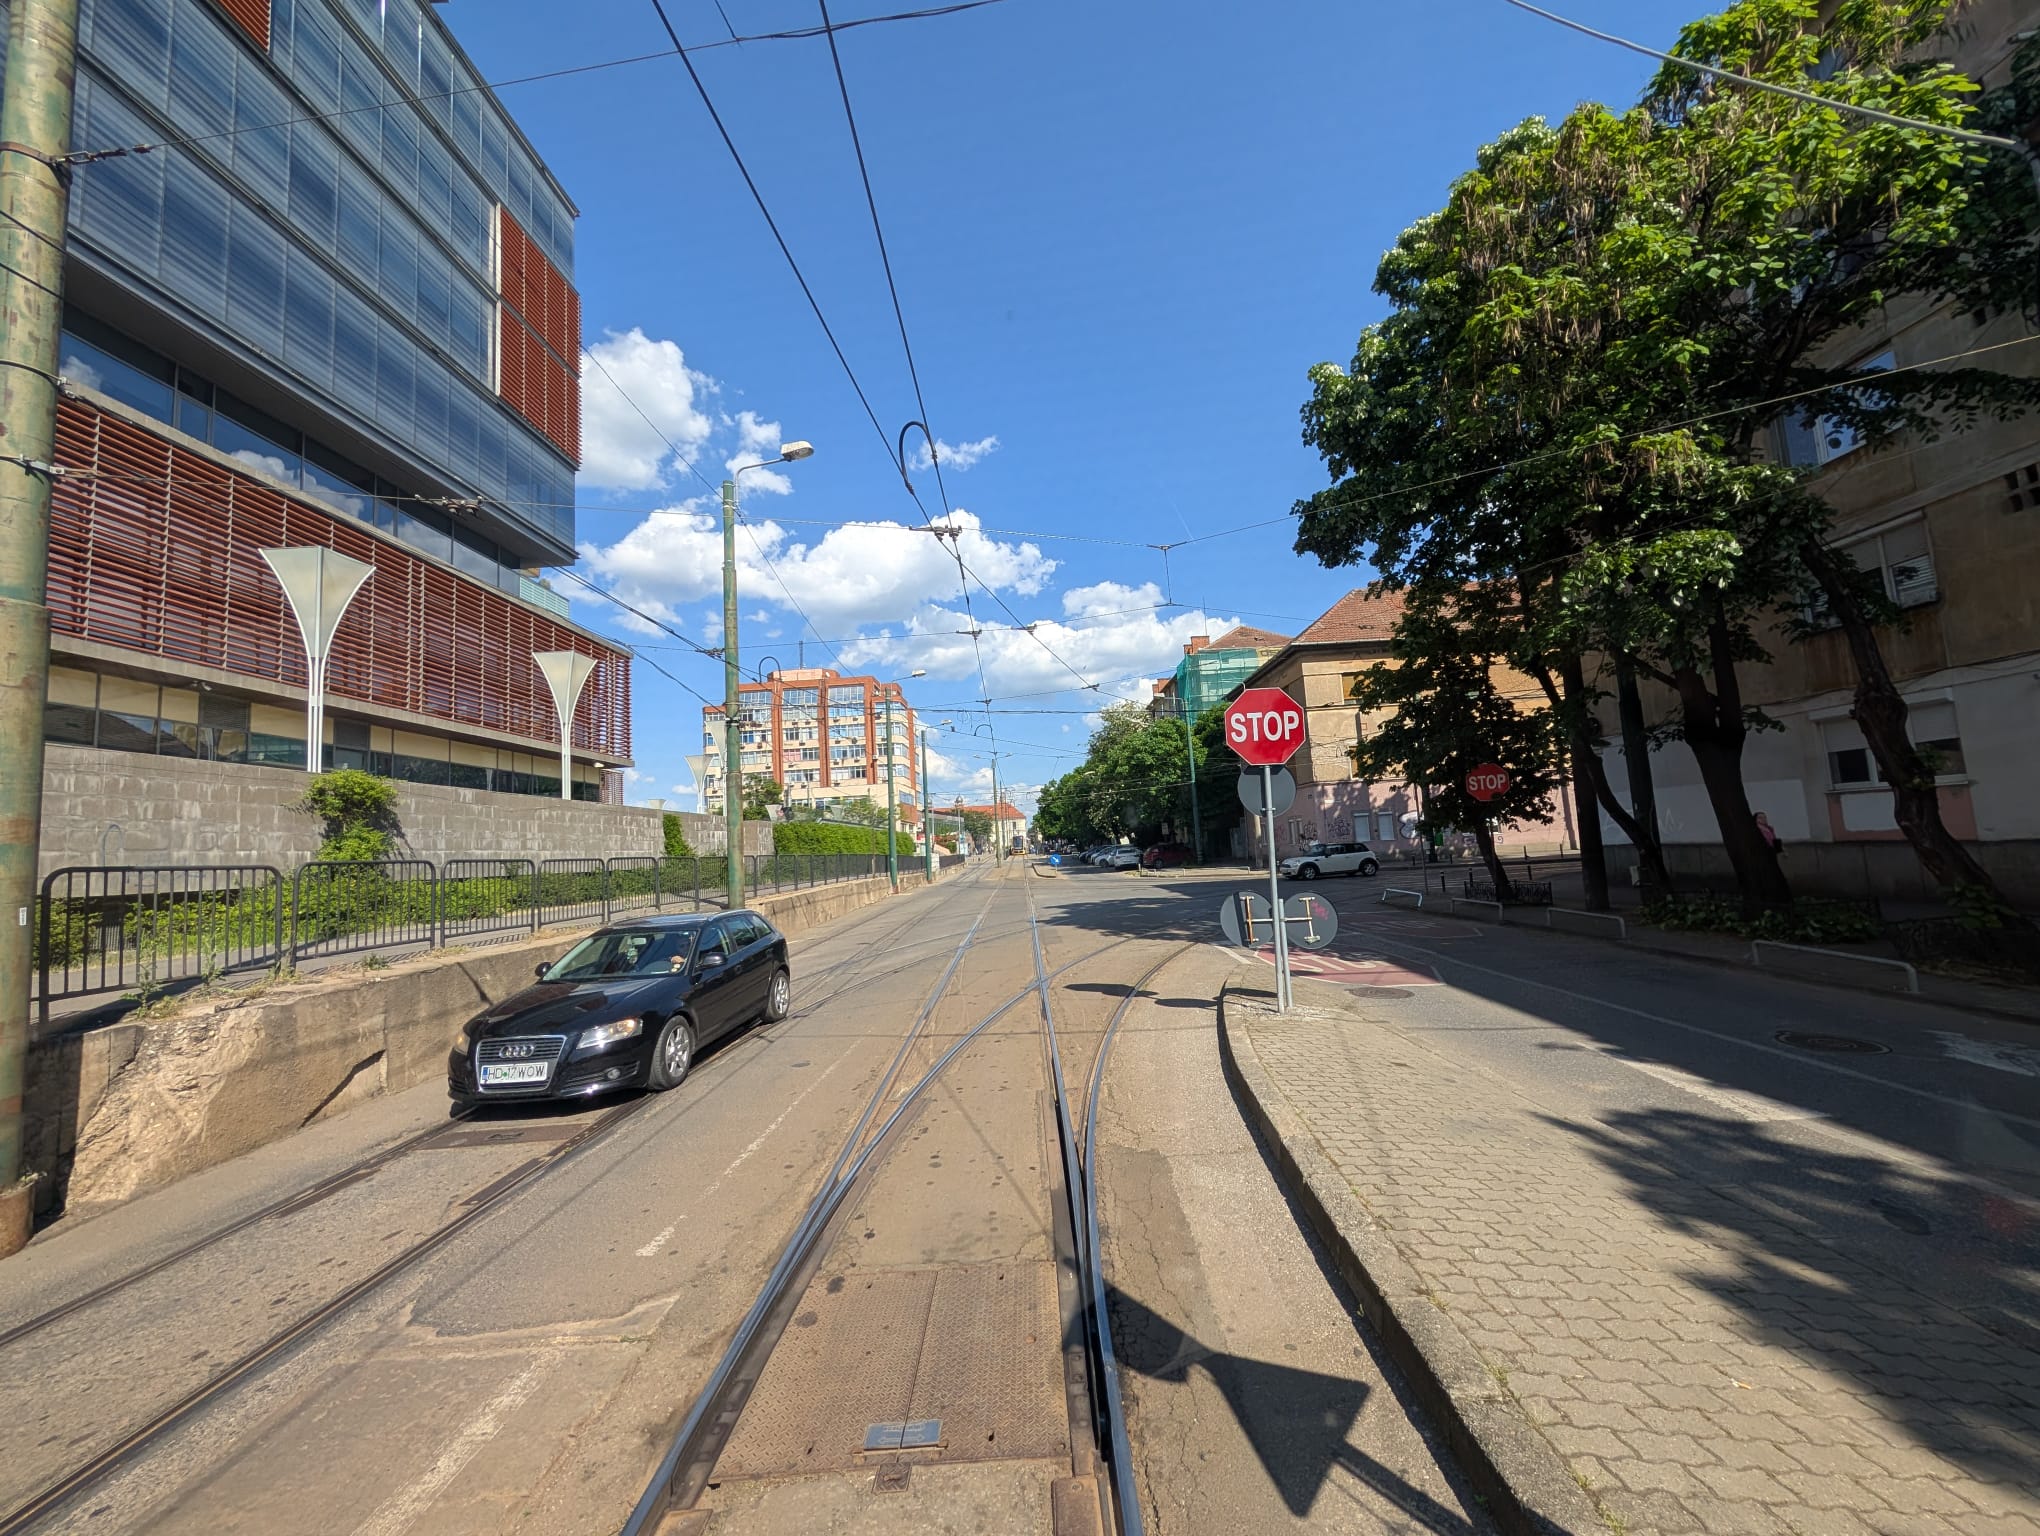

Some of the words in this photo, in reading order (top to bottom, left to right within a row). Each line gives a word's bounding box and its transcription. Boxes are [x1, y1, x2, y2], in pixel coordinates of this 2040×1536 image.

[1230, 711, 1300, 743] STOP
[1468, 774, 1506, 791] STOP
[488, 1067, 503, 1080] HD
[518, 1065, 545, 1079] WOW
